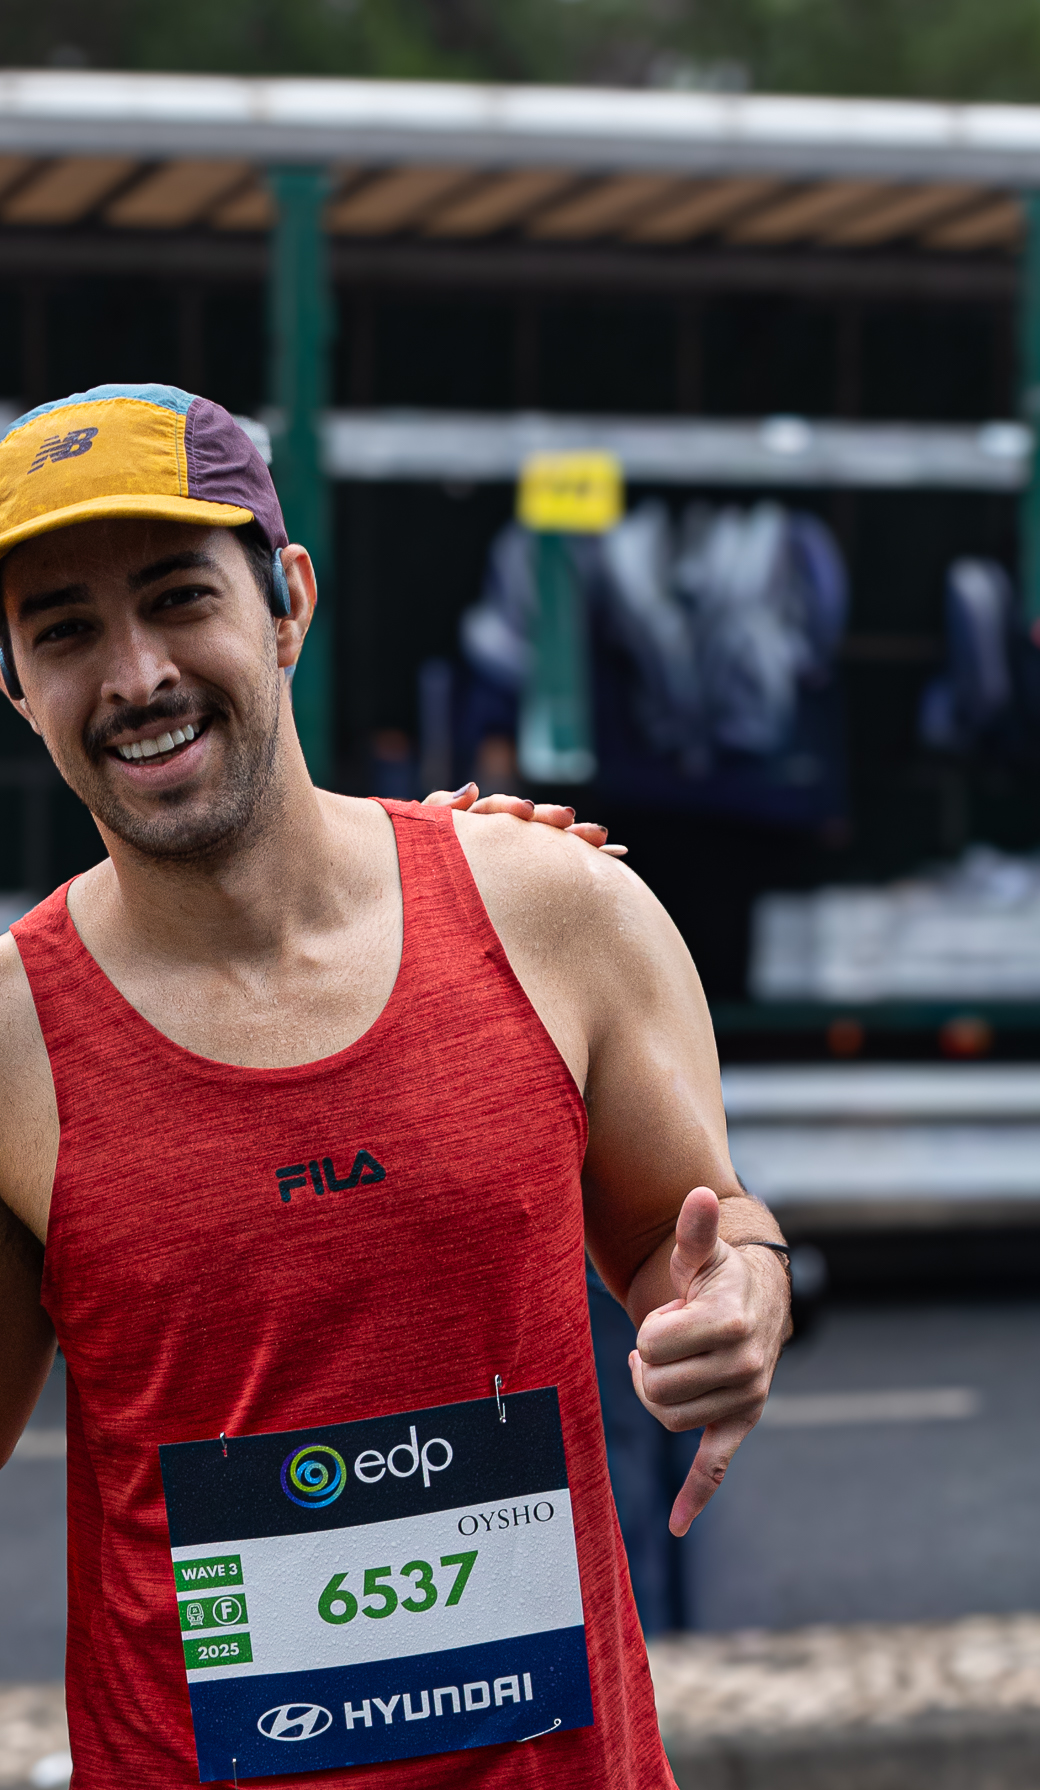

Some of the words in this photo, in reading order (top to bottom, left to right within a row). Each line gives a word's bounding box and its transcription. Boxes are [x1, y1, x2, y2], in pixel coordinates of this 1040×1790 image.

[275, 1149, 387, 1203] FILA
[354, 1425, 453, 1488] edp
[457, 1500, 555, 1536] OYSHO
[181, 1564, 226, 1581] WAVE
[229, 1563, 238, 1576] 3
[317, 1550, 479, 1625] 6537
[220, 1601, 232, 1620] F
[197, 1642, 240, 1660] 2025
[344, 1672, 534, 1730] HYUNDAI
